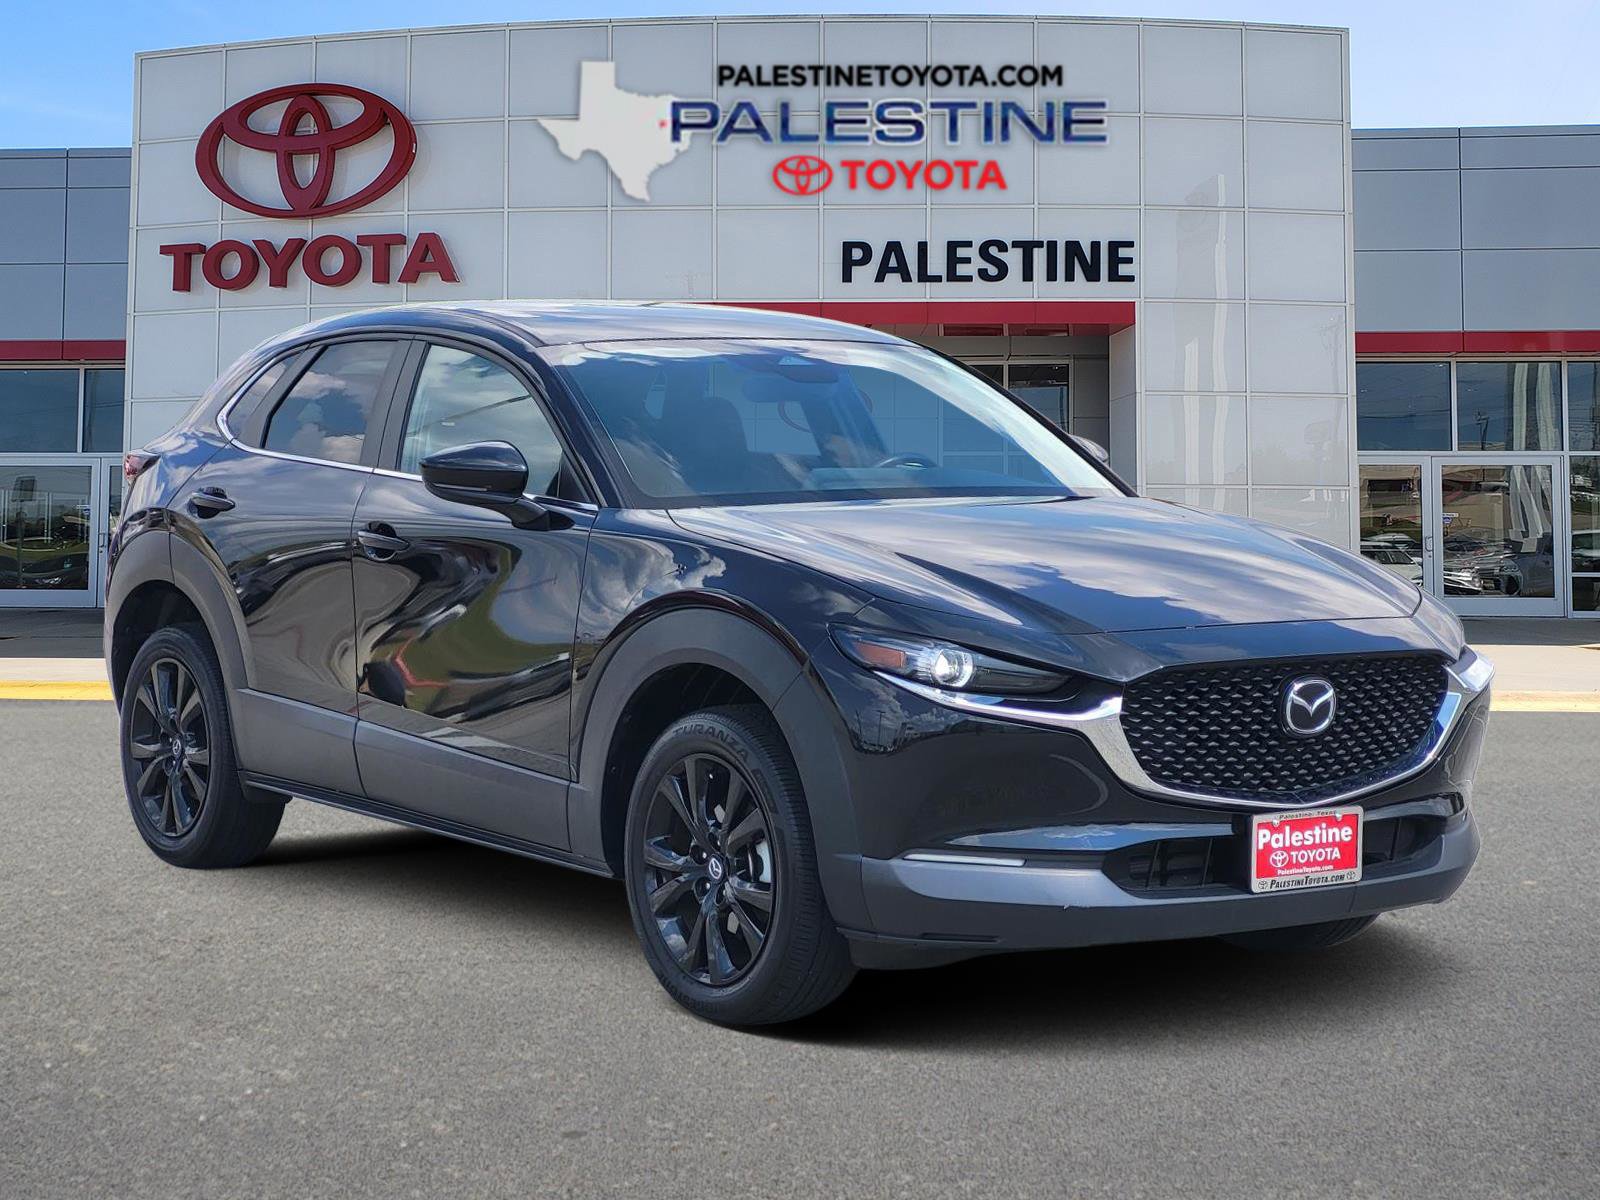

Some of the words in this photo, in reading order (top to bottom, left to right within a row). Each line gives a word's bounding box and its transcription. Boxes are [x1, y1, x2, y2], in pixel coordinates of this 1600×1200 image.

[159, 232, 460, 292] TOYOTA
[841, 240, 1136, 284] PALESTINE
[672, 723, 750, 760] TURANZA
[1258, 823, 1353, 850] Palestine
[1290, 847, 1341, 864] TOYOTA
